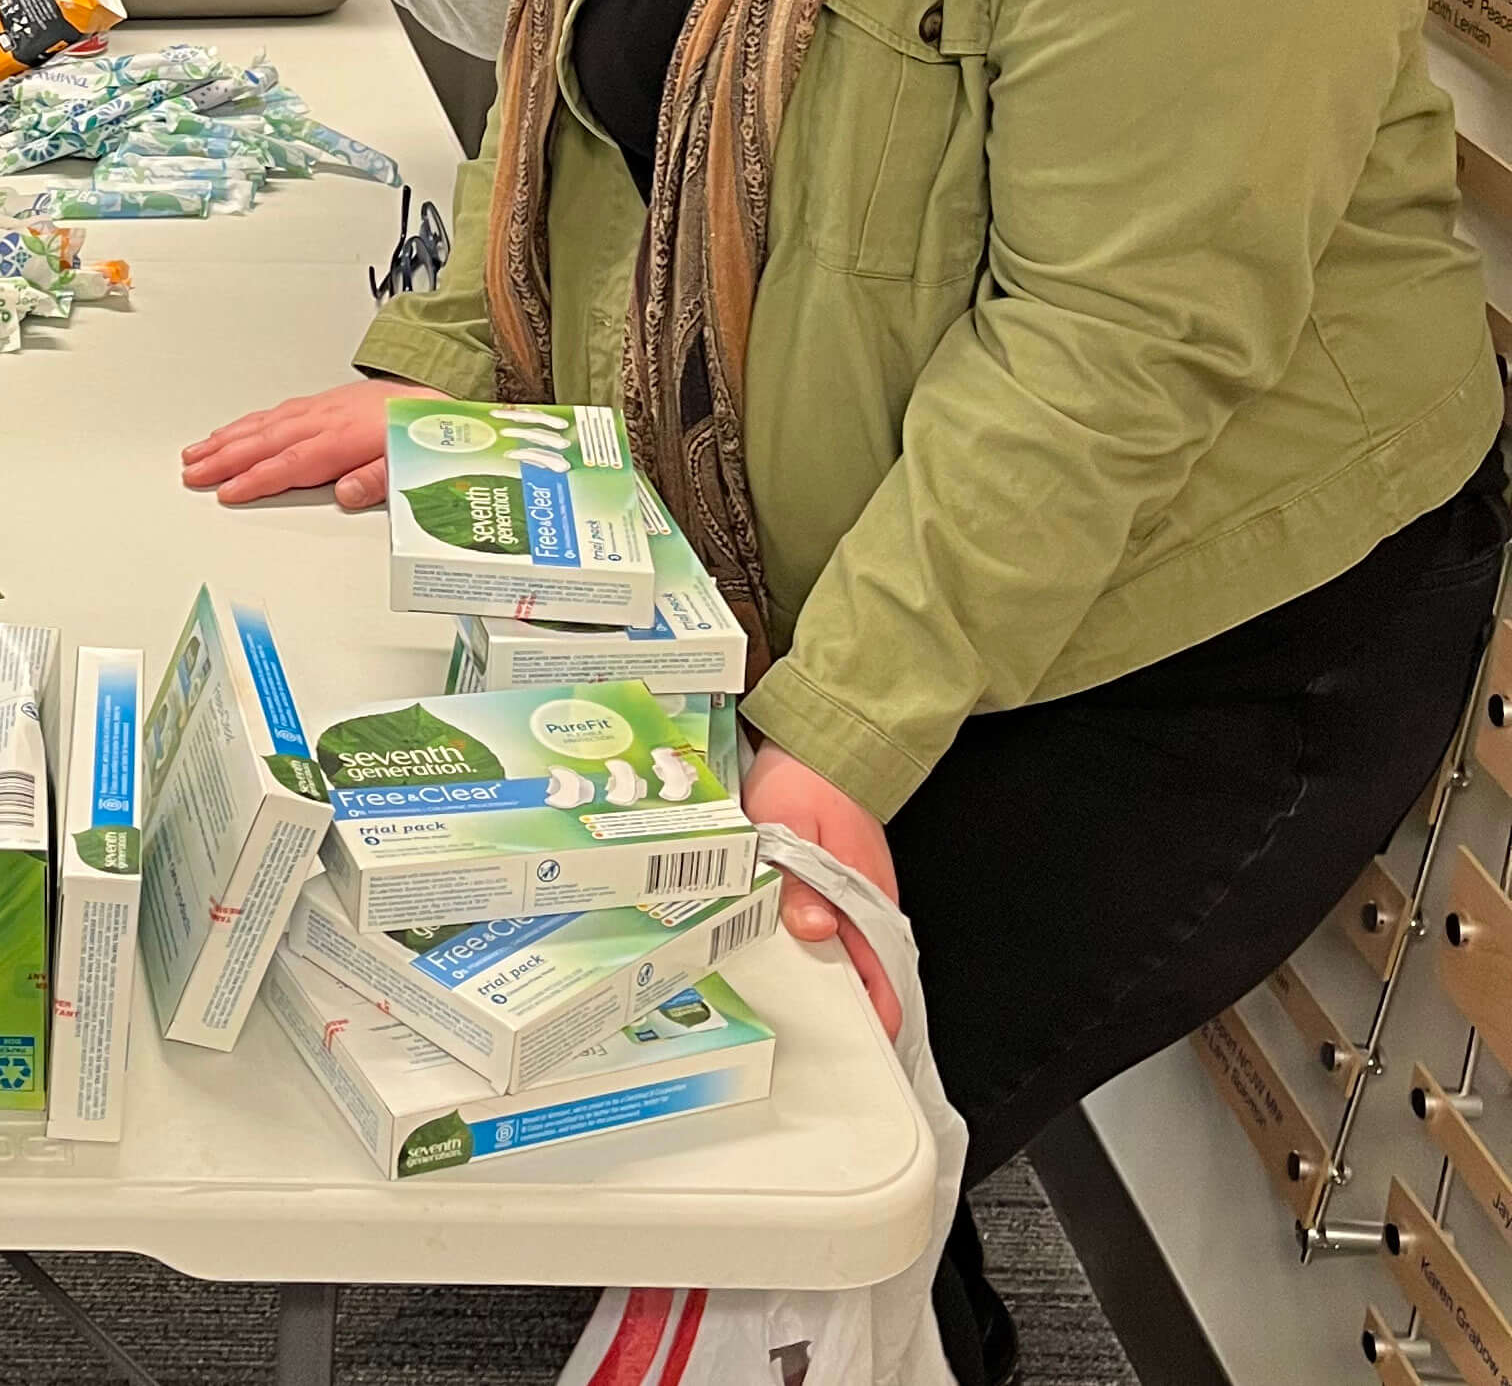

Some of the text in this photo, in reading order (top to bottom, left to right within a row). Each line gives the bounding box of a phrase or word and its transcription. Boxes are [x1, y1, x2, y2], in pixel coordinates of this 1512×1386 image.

[464, 485, 497, 544] seventh
[545, 718, 613, 734] PureFit
[339, 745, 466, 767] seventh
[346, 762, 478, 783] generation.
[359, 821, 448, 836] trial pack
[477, 953, 545, 996] trial pack
[407, 1137, 462, 1161] seventh
[1420, 1255, 1454, 1314] Karen
[1456, 1306, 1500, 1377] Grabow
